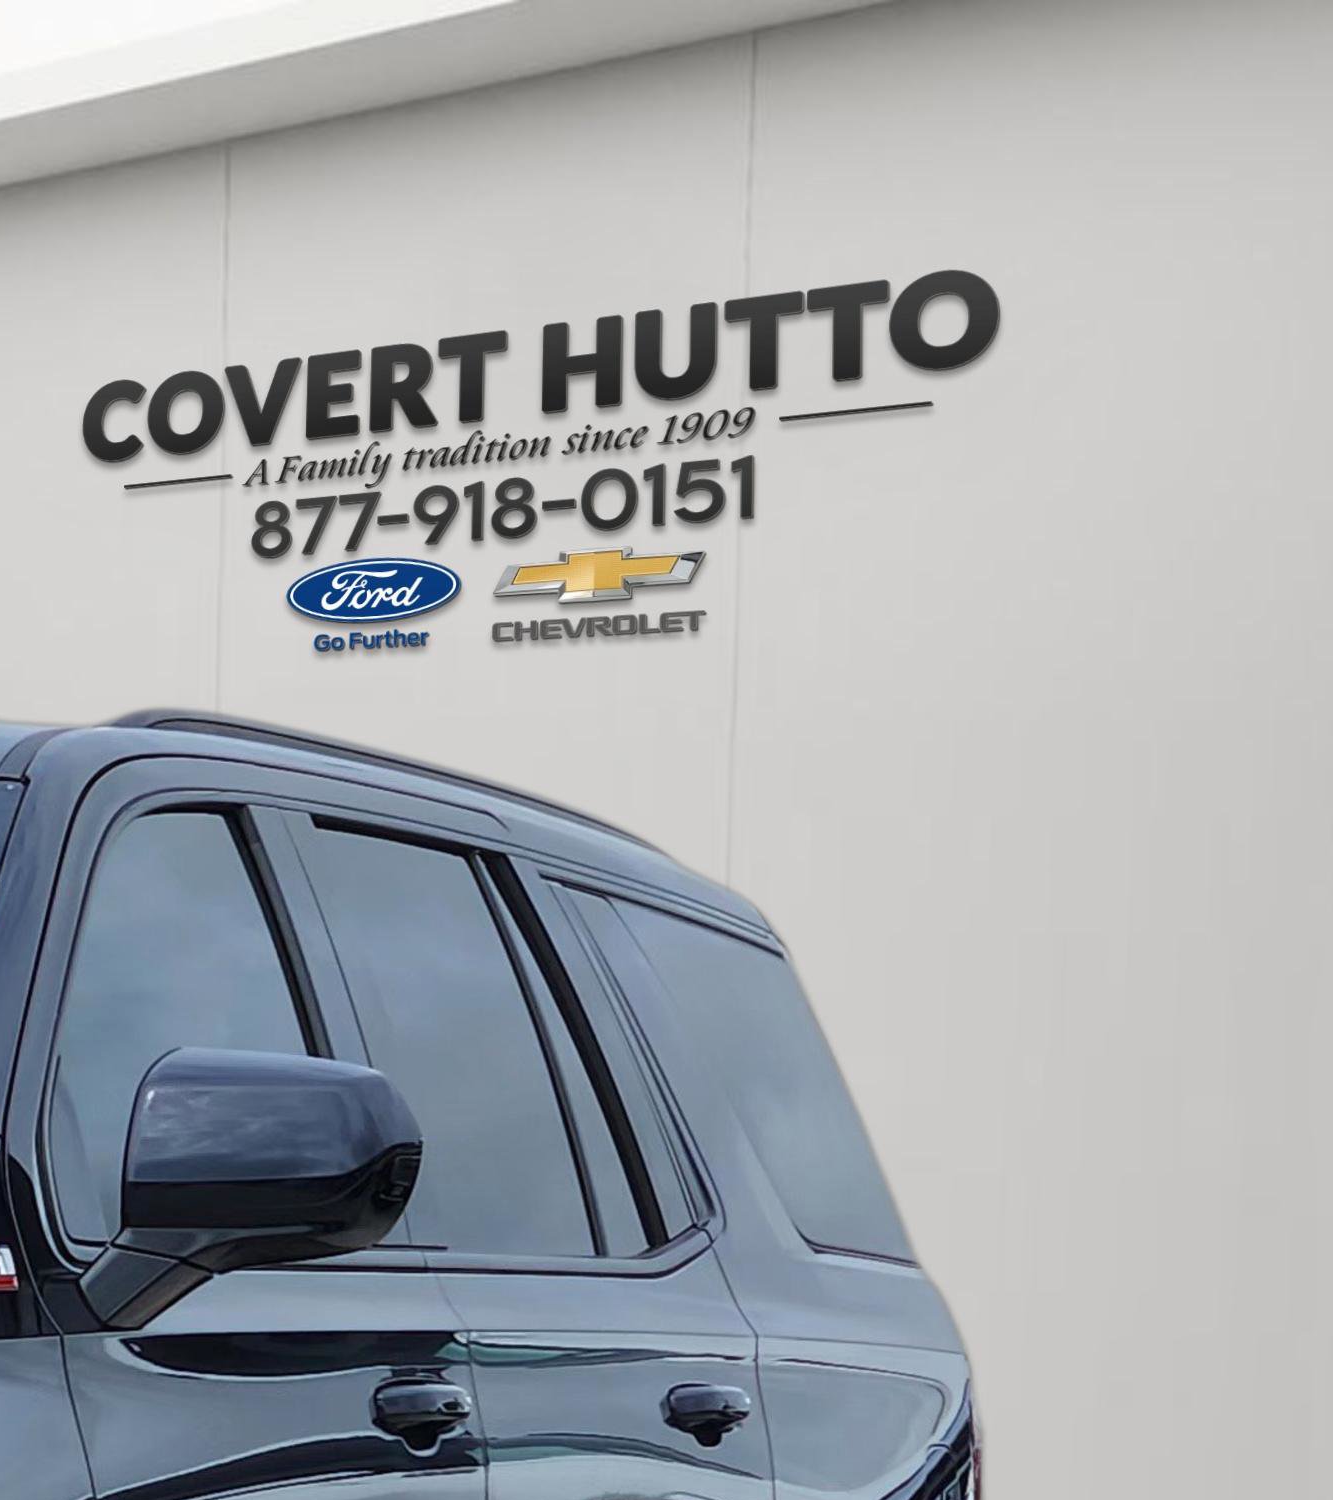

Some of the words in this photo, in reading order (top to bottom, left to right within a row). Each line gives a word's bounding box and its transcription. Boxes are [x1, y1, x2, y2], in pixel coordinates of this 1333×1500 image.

[81, 329, 509, 464] COVERT
[540, 268, 1002, 413] HUTTO
[242, 458, 268, 487] A
[277, 440, 392, 488] Family
[402, 429, 551, 473] tradition
[561, 424, 650, 456] since
[656, 406, 757, 445] 1909
[250, 454, 756, 559] 877-918-0151
[319, 563, 425, 611] Ford
[313, 632, 346, 652] Go
[348, 627, 430, 650] Further
[491, 609, 707, 643] CHEVROLET
